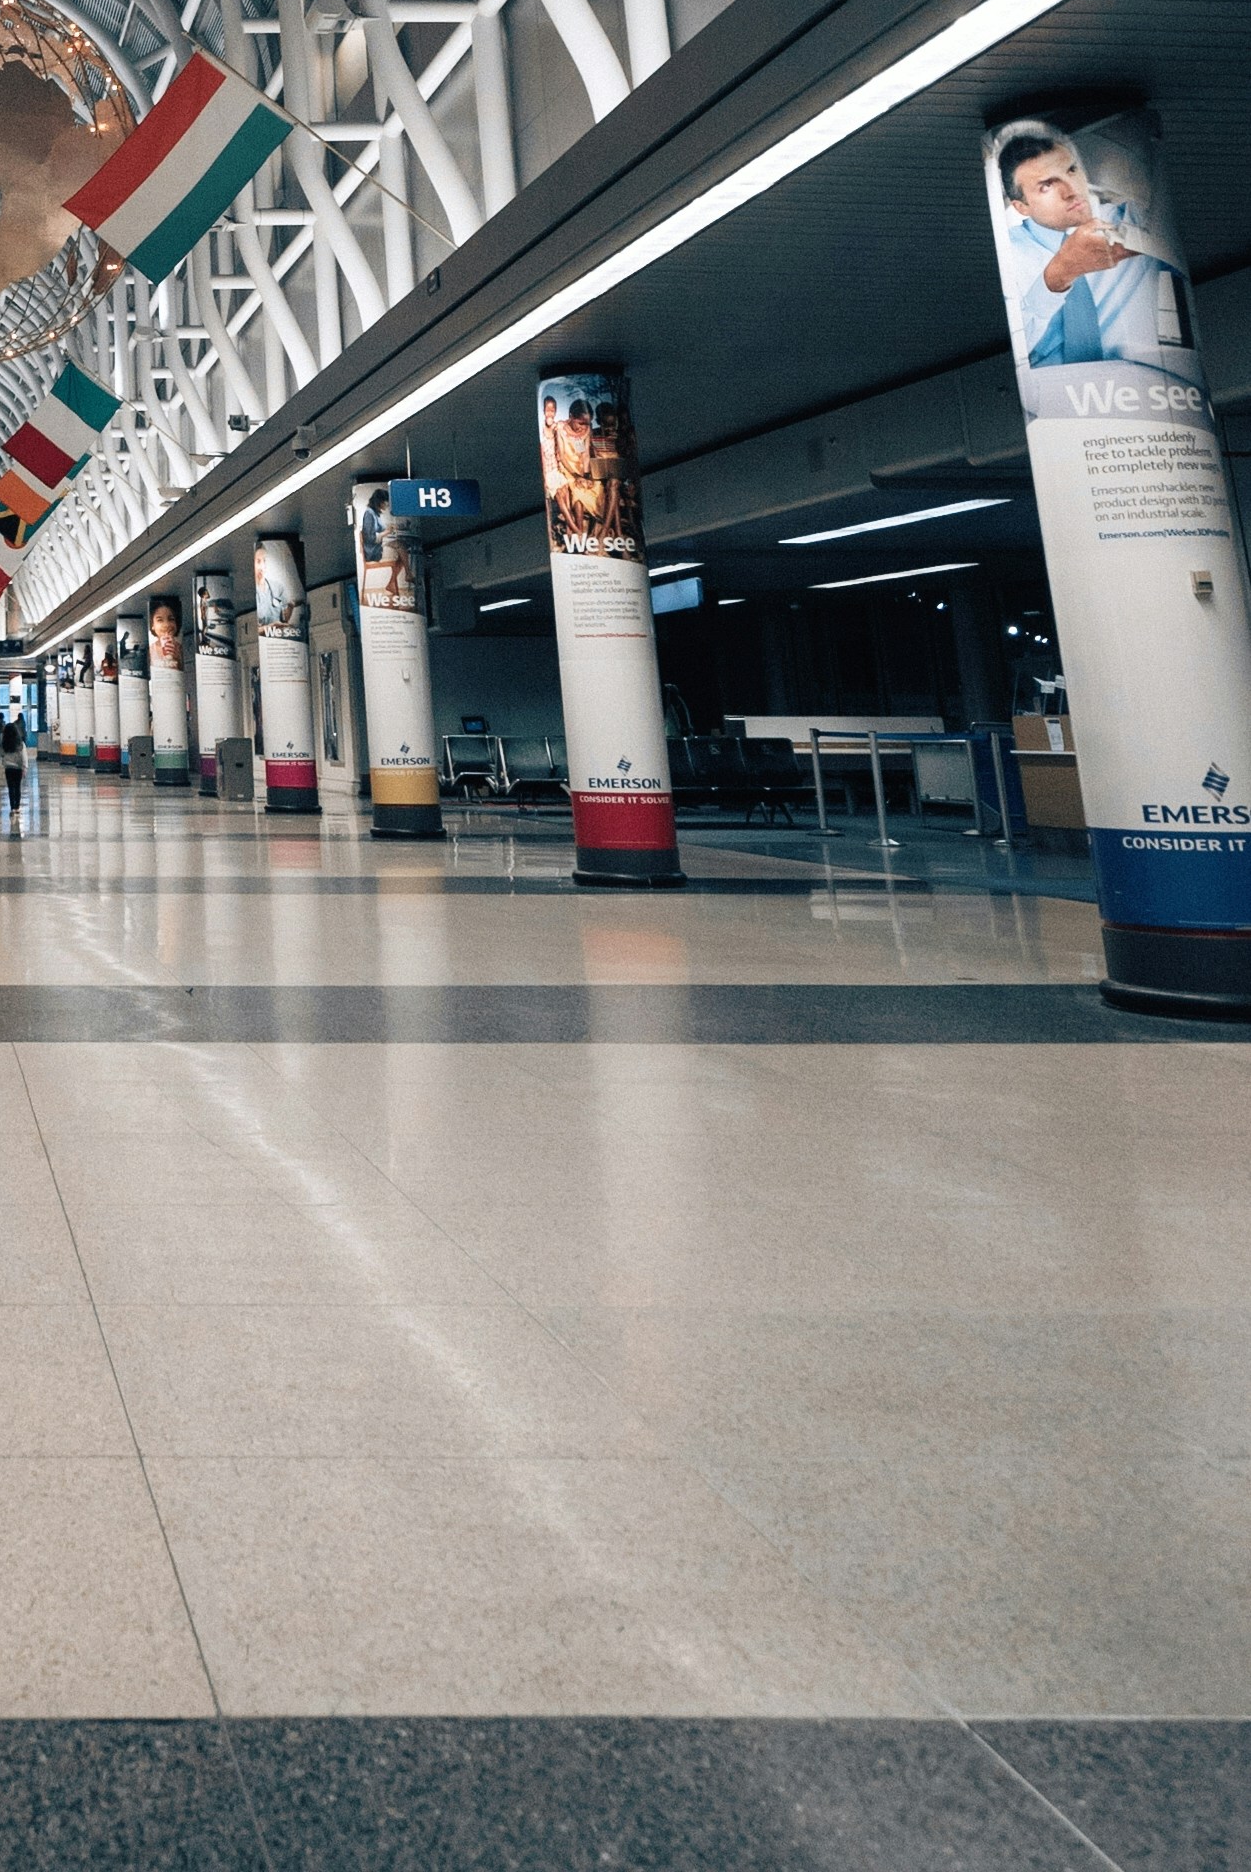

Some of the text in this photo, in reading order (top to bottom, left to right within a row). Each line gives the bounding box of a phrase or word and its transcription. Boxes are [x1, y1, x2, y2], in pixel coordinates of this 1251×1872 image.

[1065, 380, 1202, 417] We see
[1083, 431, 1196, 449] engineers suddenly
[1085, 449, 1109, 461] free
[1111, 448, 1126, 460] to
[1128, 445, 1167, 459] tackle
[1088, 464, 1100, 476] in
[1101, 459, 1175, 475] completely
[1177, 461, 1199, 471] new
[1091, 485, 1140, 497] Emerson
[1141, 481, 1197, 494] unshackles
[418, 487, 452, 508] H3
[1094, 498, 1137, 511] product
[1139, 496, 1177, 508] design
[1178, 494, 1199, 506] with
[1096, 508, 1207, 523] on an industrial scale.
[563, 533, 636, 554] We see
[367, 593, 415, 607] We see
[264, 626, 301, 637] We see
[199, 645, 229, 656] We see
[381, 757, 430, 765] EMERSON
[588, 777, 661, 789] EMERSON
[579, 795, 625, 804] CONSIDER
[628, 795, 638, 805] IT
[1142, 804, 1251, 825] EMERS
[1122, 836, 1246, 852] CONSIDER IT
